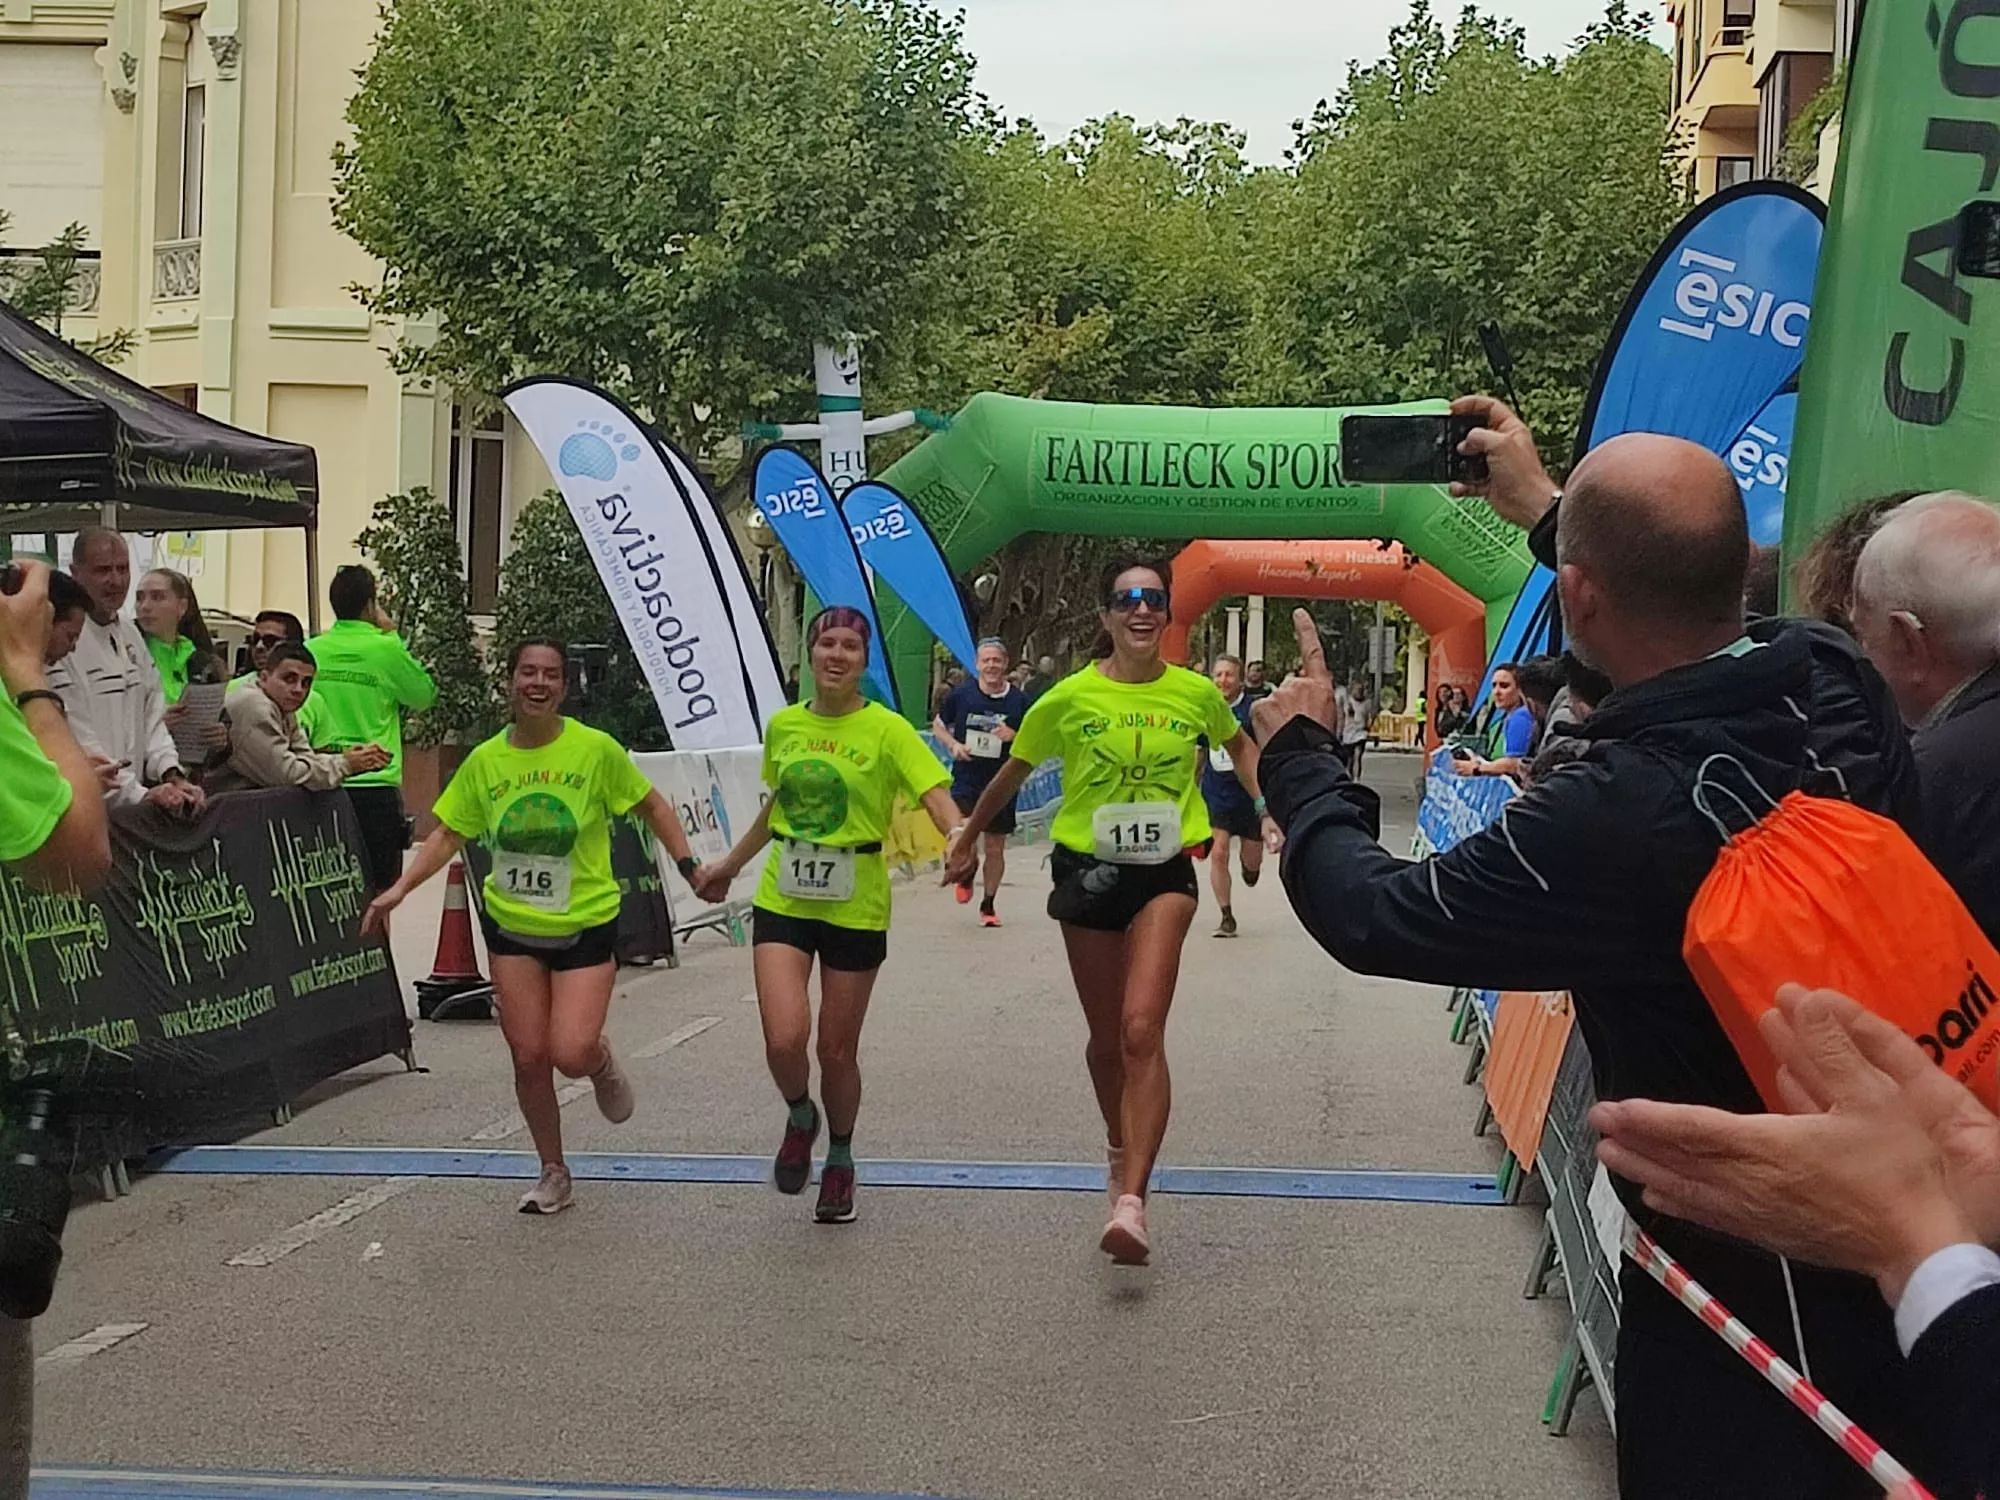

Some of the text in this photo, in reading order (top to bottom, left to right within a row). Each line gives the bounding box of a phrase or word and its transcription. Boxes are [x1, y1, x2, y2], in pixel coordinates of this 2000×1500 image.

[1044, 436, 1361, 490] FARTLECK SPOR
[1260, 497, 1282, 509] DE
[1286, 496, 1358, 510] EVENTOS
[1345, 551, 1398, 564] Huesca
[1116, 712, 1156, 729] JUAN
[801, 739, 838, 755] JUAN
[515, 769, 550, 790] JUAN
[1109, 823, 1161, 844] 115
[506, 867, 553, 889] 116
[791, 858, 836, 879] 117
[320, 884, 361, 939] Sport
[196, 918, 248, 979] Sport
[51, 936, 102, 1005] Sport
